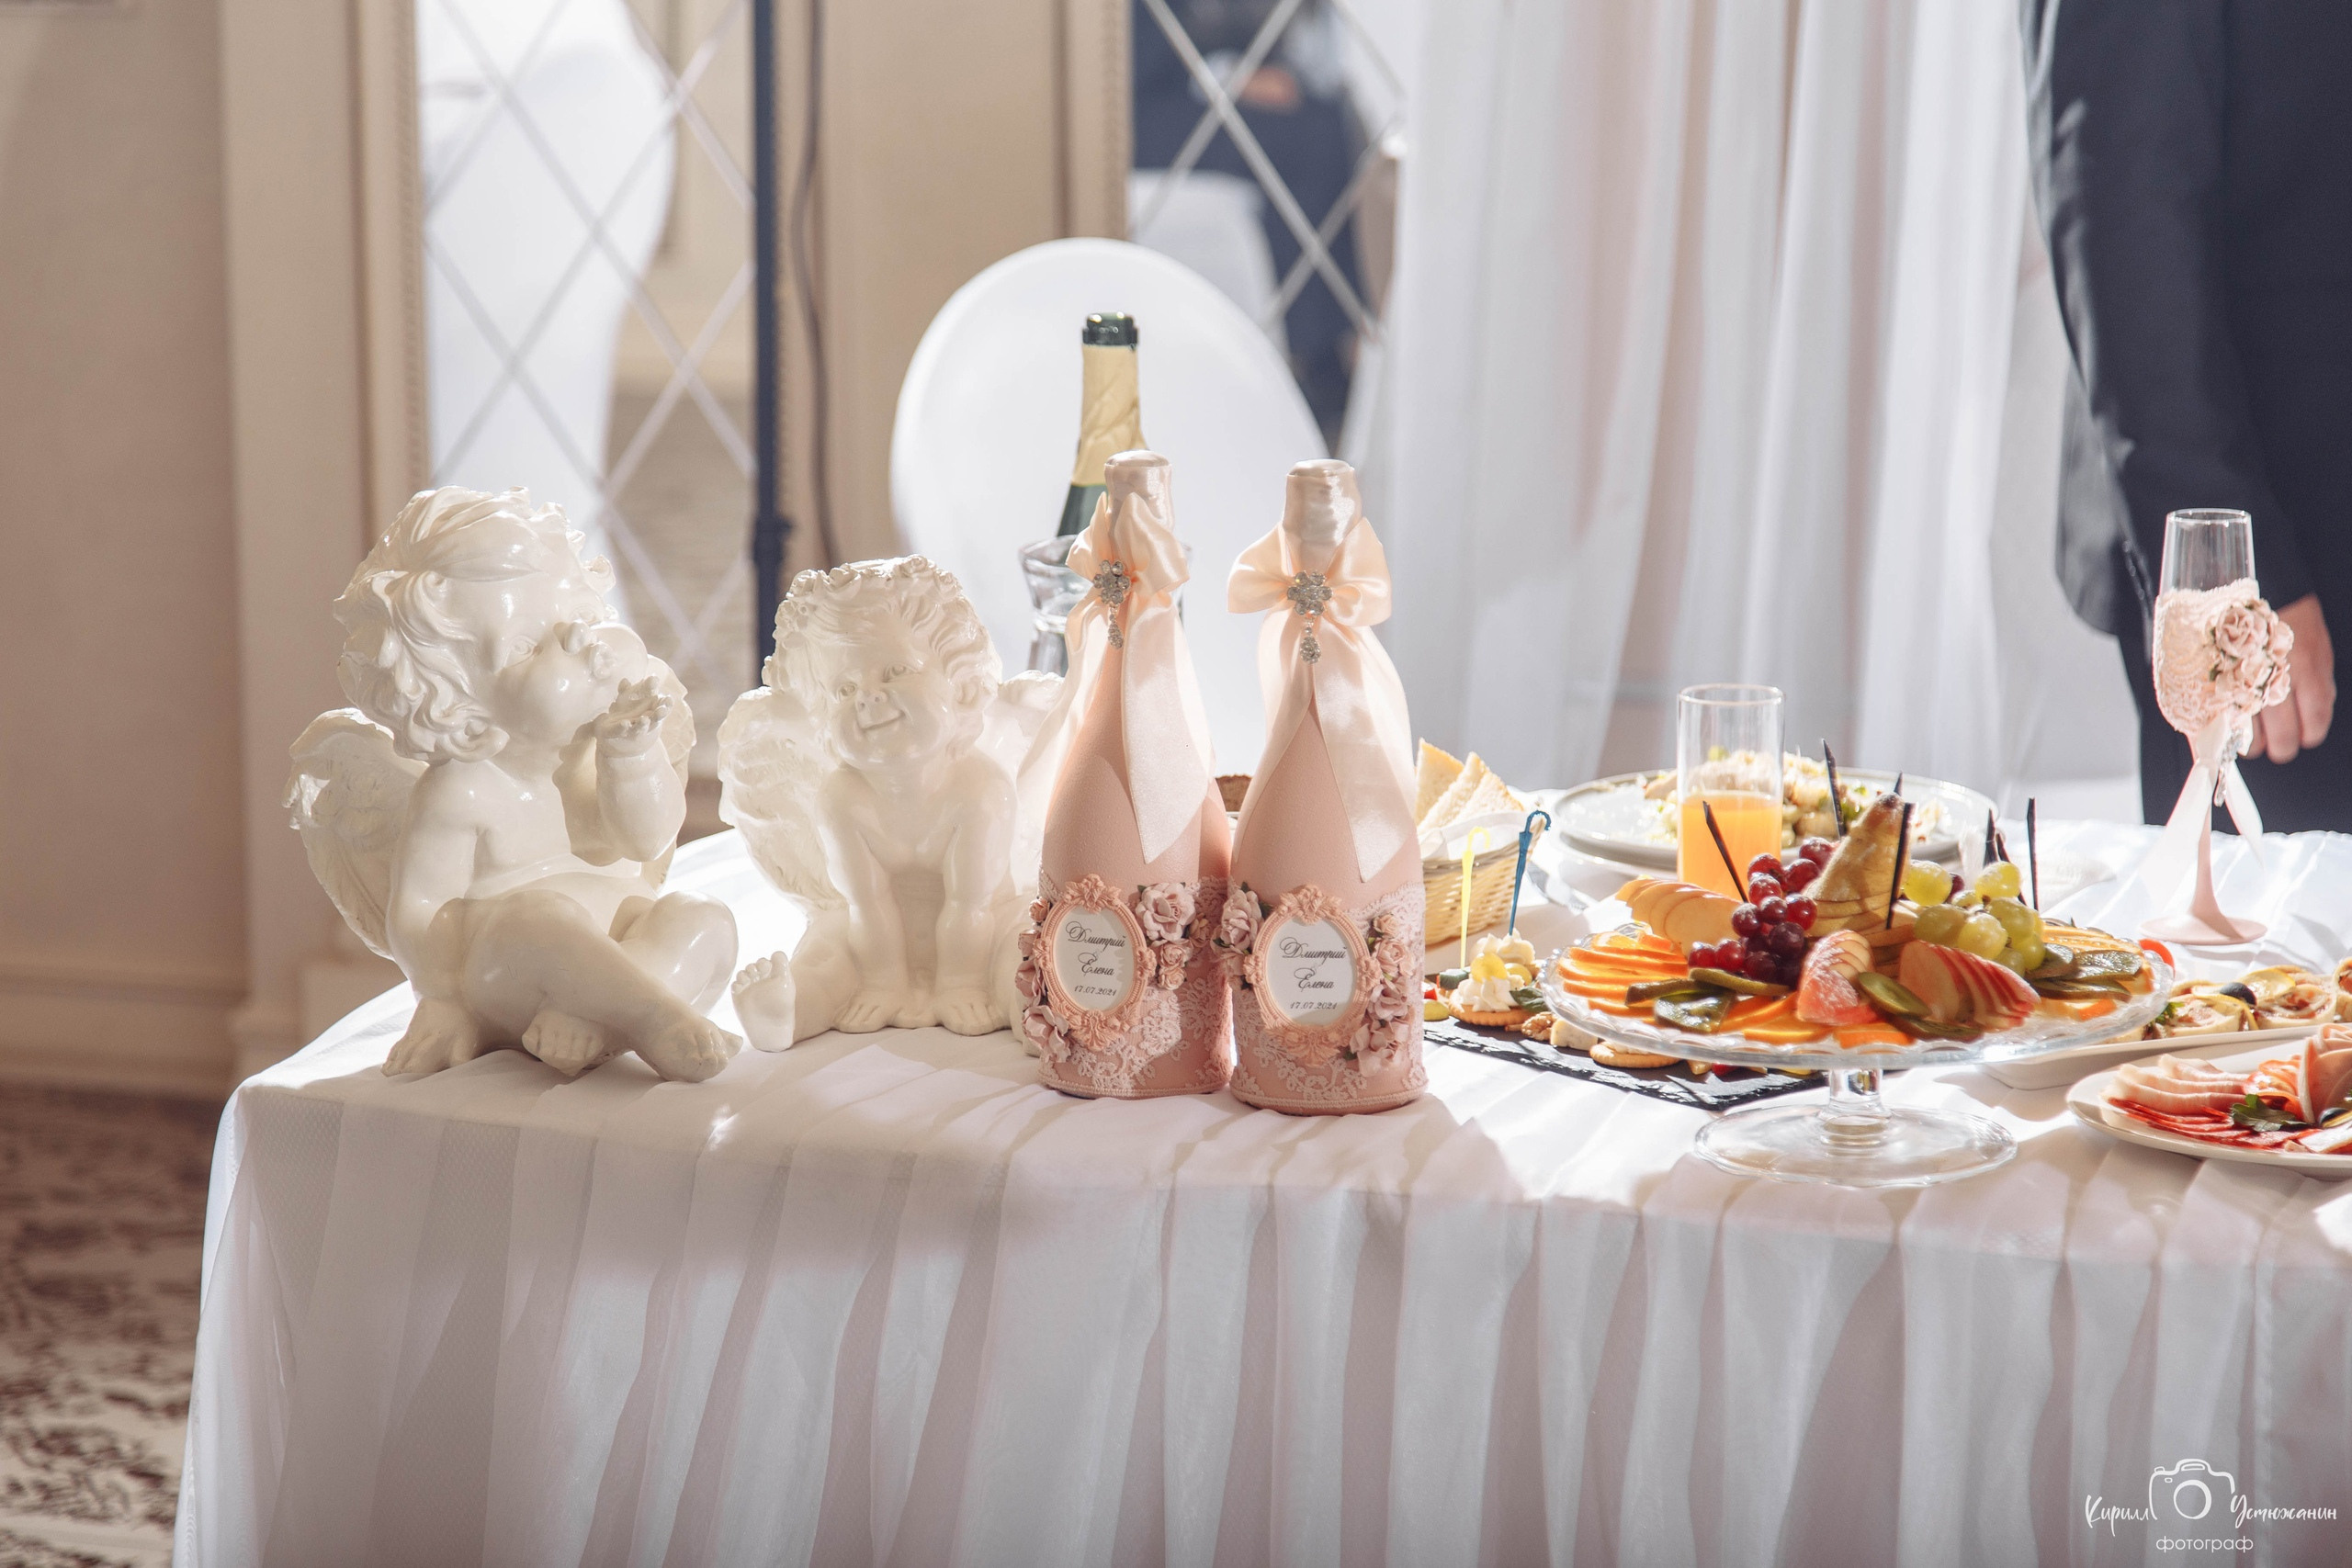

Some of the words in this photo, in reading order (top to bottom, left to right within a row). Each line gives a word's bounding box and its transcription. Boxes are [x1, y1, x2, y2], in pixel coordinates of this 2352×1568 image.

[1066, 921, 1126, 952] Дмитрий
[1280, 937, 1348, 967] Дмитрий
[1078, 953, 1115, 976] Елена
[1073, 985, 1118, 997] 17.07.2021
[1294, 967, 1336, 992] Елена
[1290, 1001, 1339, 1010] 17.07.2021
